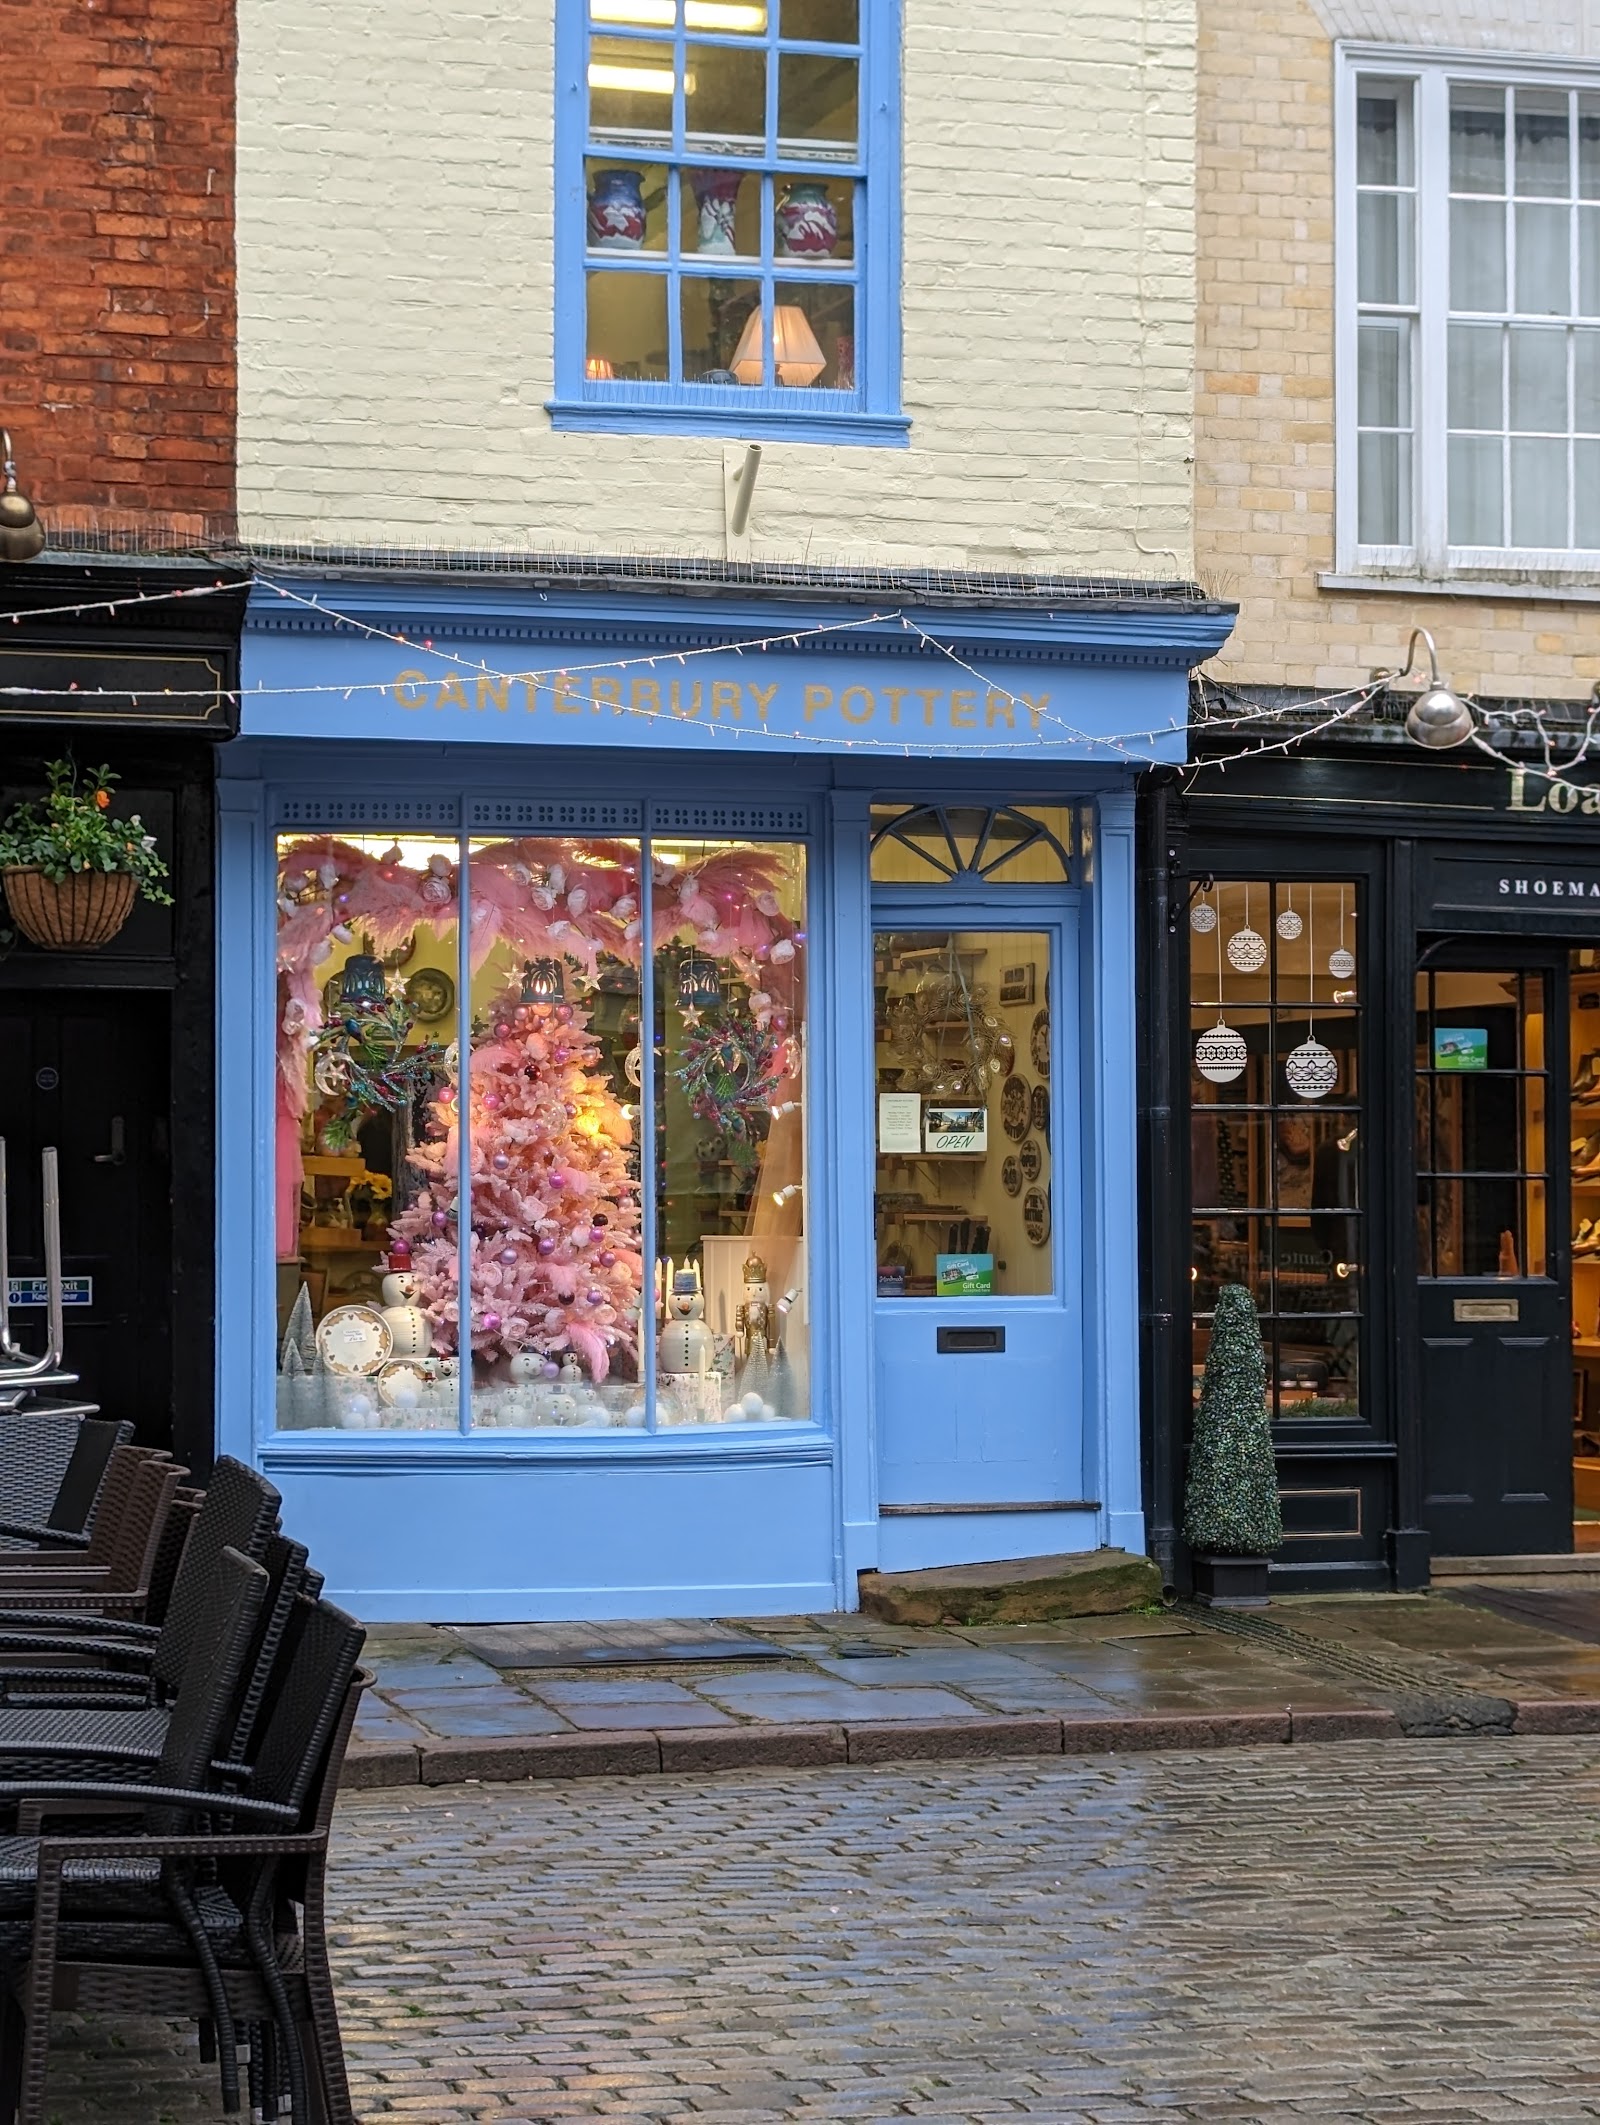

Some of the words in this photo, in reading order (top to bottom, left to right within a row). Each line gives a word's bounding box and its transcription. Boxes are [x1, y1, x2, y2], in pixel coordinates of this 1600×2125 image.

[393, 669, 780, 721] CANTERBURY
[803, 684, 1050, 730] POTTERY
[1499, 879, 1600, 897] SHOEMA
[936, 1135, 975, 1149] OPEN
[32, 1281, 48, 1292] Fir
[32, 1292, 48, 1301] Kee
